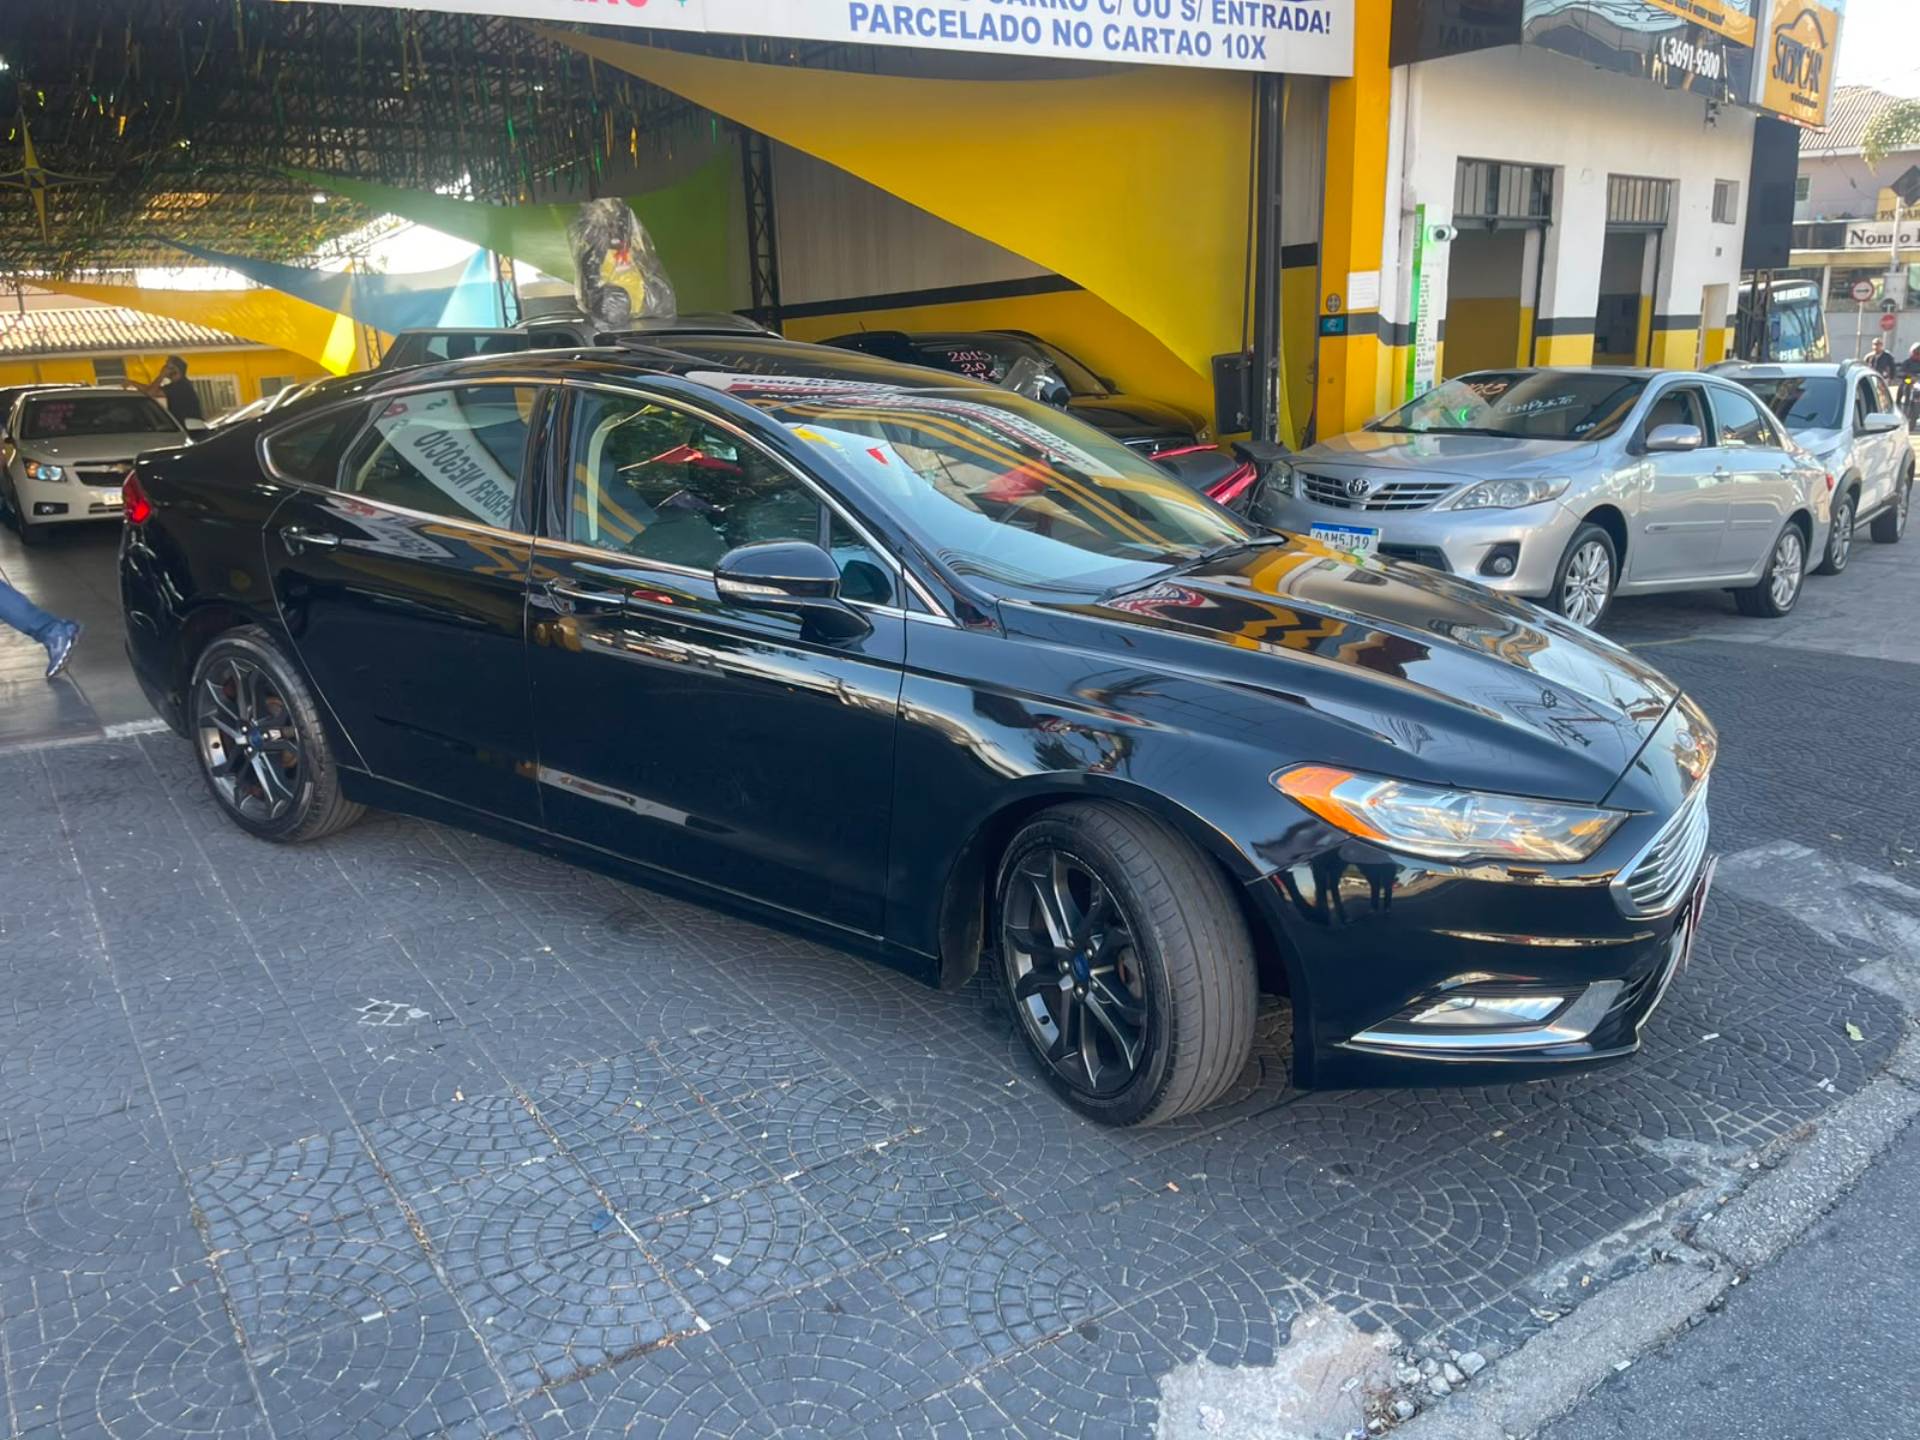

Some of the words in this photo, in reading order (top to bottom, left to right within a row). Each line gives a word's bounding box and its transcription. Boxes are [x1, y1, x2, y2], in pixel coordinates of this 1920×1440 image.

[849, 2, 1042, 44] PARCELADO
[1052, 18, 1093, 48] NO
[1102, 23, 1212, 57] CARTAO
[1221, 33, 1267, 60] 10X
[1212, 0, 1331, 35] ENTRADA!
